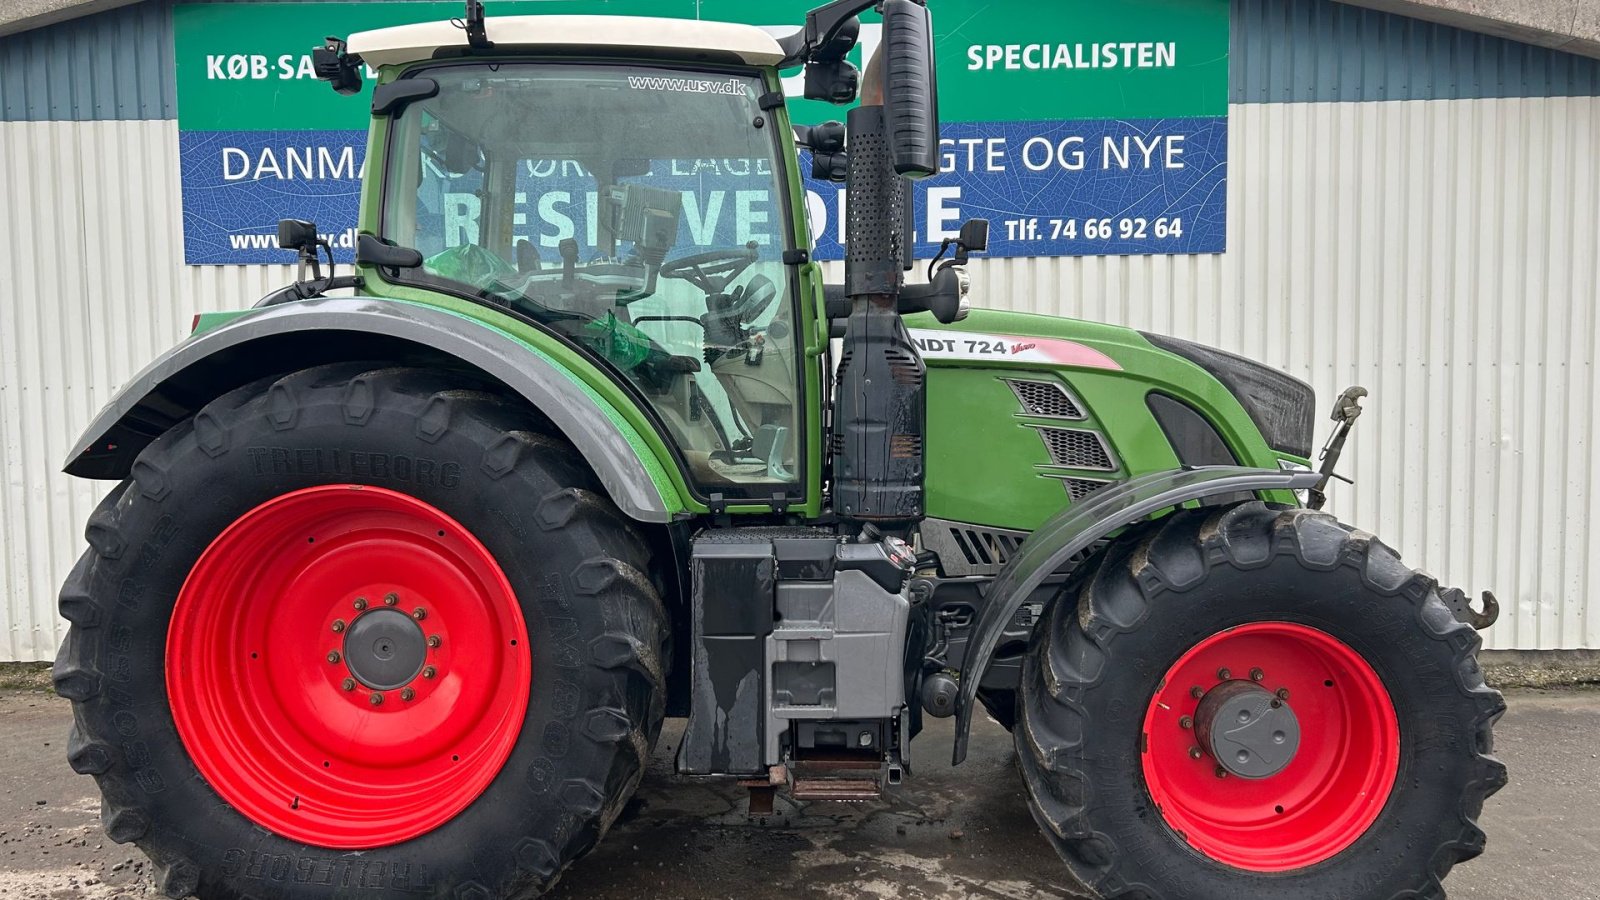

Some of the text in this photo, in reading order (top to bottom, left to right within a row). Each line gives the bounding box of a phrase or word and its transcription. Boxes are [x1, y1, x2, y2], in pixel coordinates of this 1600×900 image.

[967, 42, 1176, 71] SPECIALISTEN
[628, 76, 746, 96] www.usv.dk
[938, 138, 1006, 172] GTE
[1022, 138, 1085, 171] OG
[1103, 135, 1186, 168] NYE
[1005, 217, 1182, 241] Tlf. 74 66 92 64
[912, 338, 956, 352] NDT
[964, 340, 1007, 354] 724
[247, 446, 465, 491] TRELLEBORG
